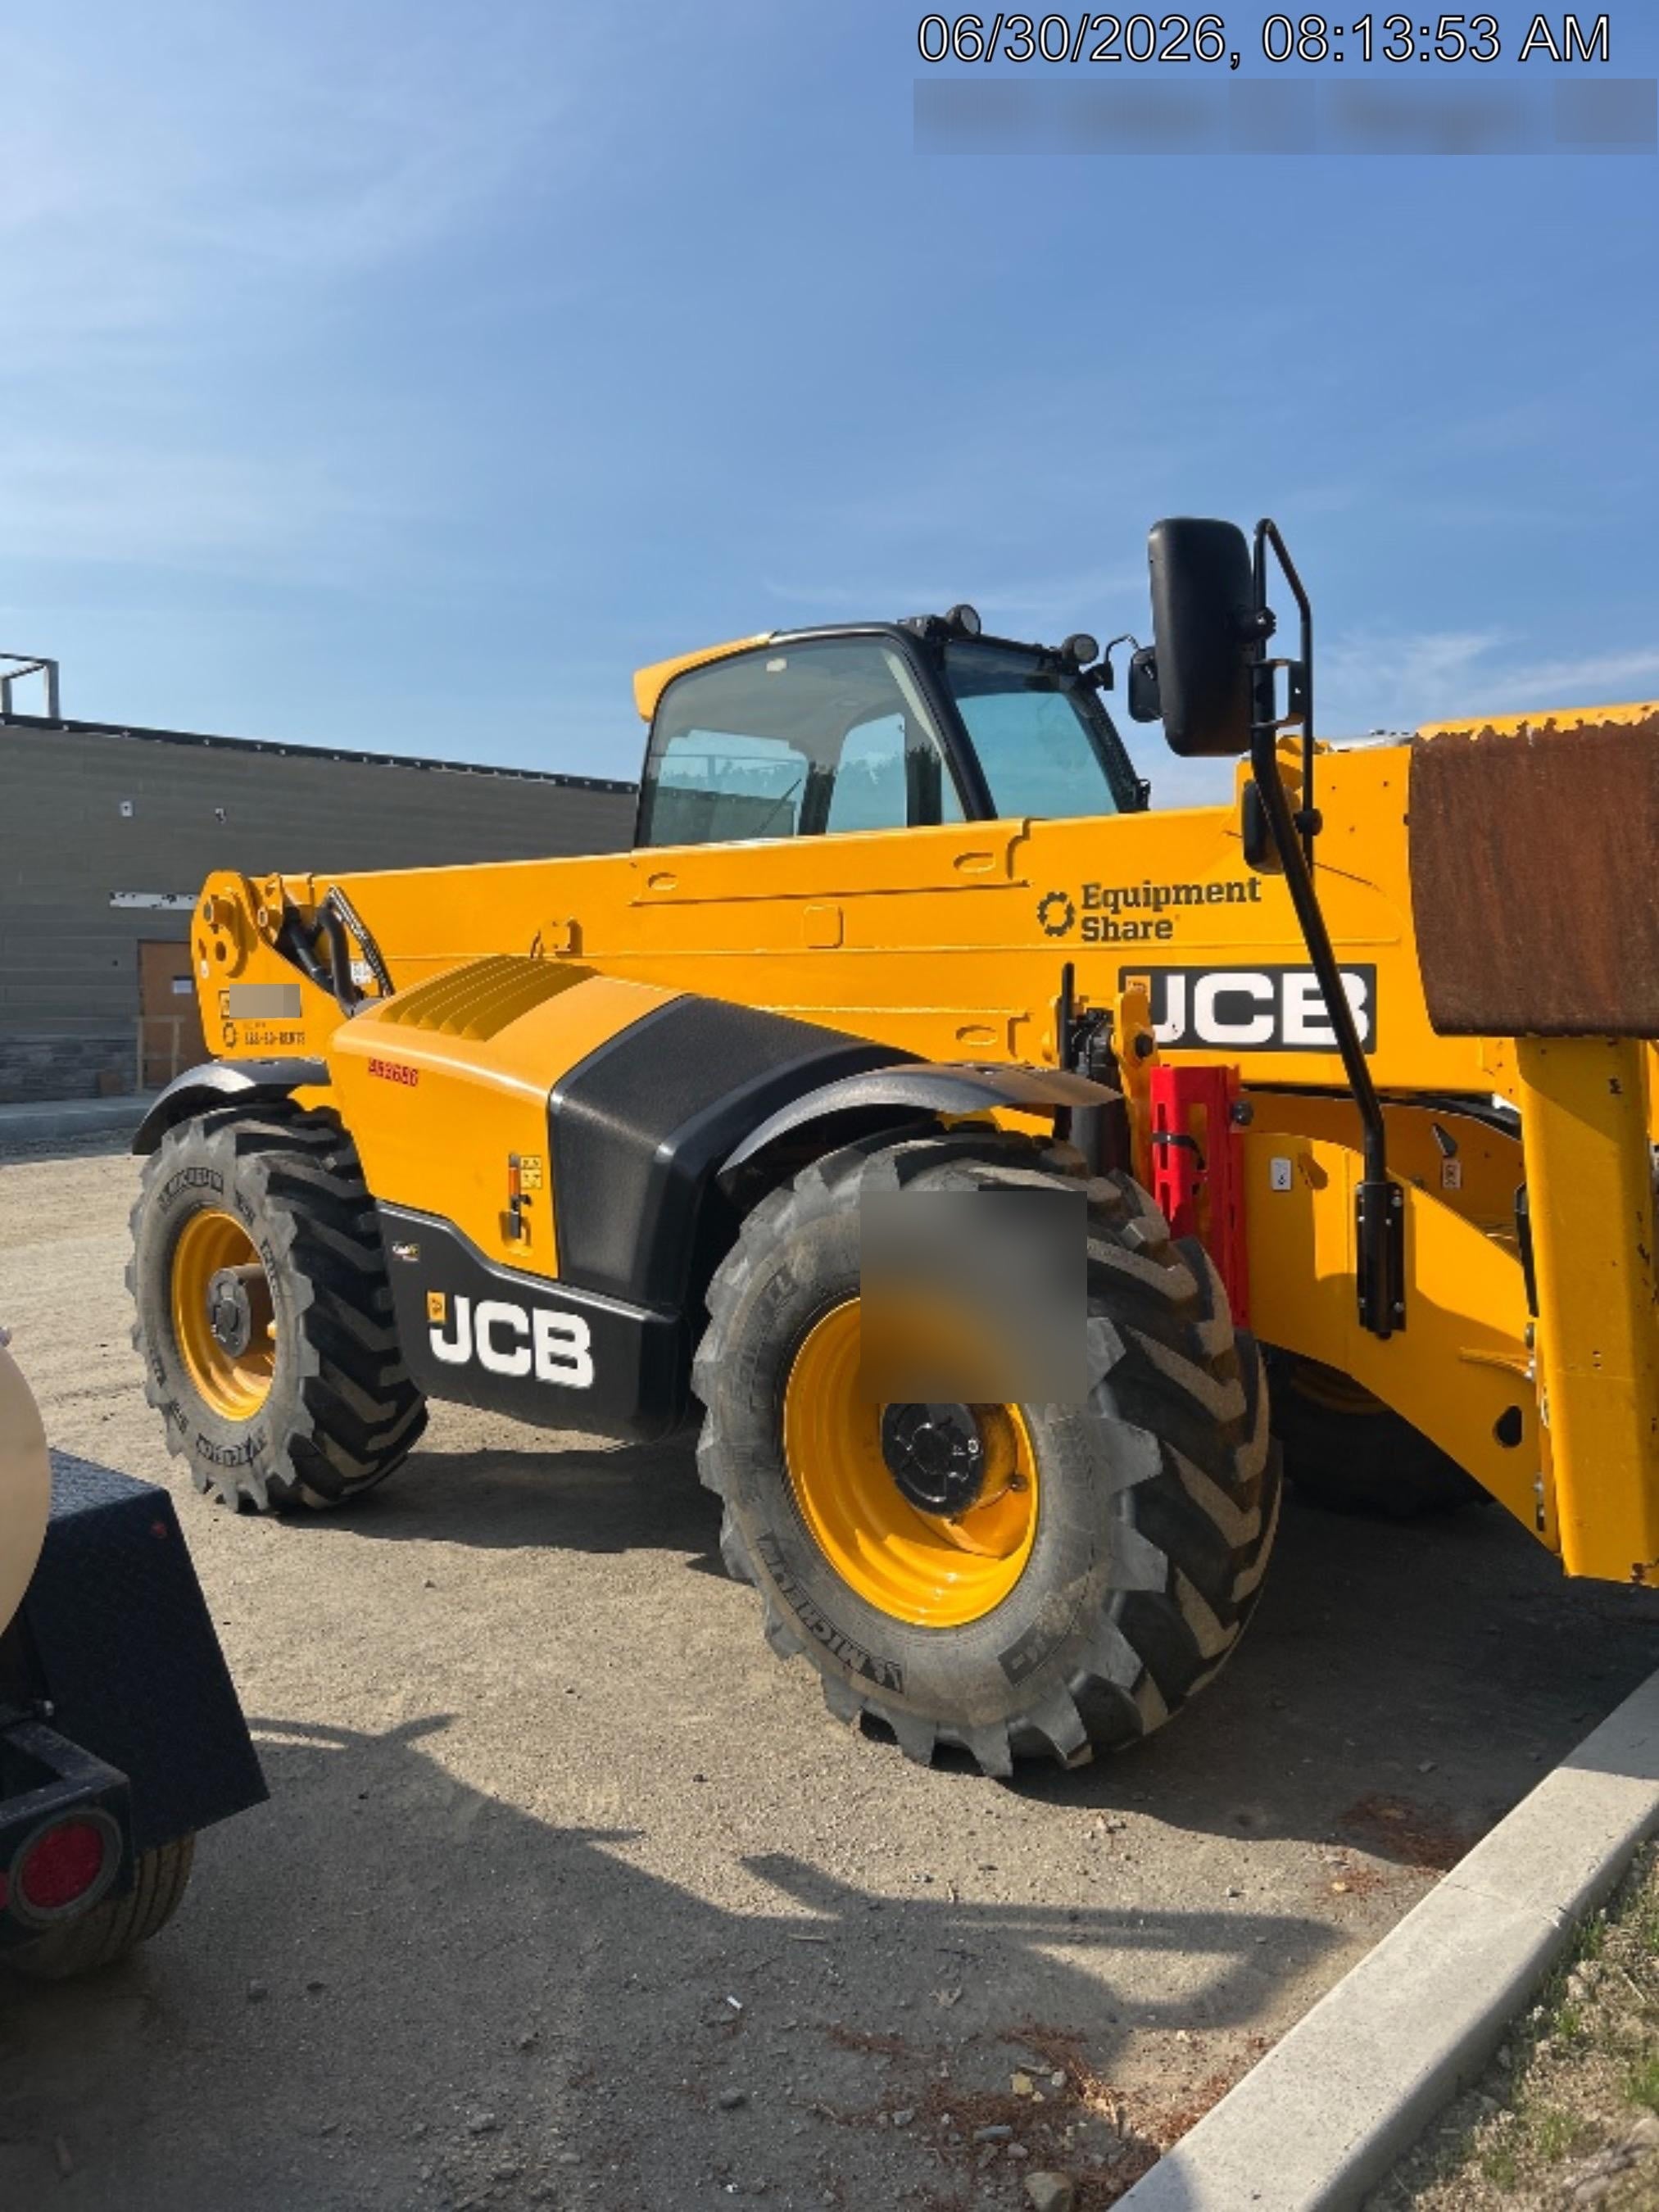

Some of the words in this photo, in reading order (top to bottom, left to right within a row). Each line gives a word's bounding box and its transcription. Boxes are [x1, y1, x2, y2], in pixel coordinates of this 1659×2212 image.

[1081, 877, 1262, 914] Equipment
[1081, 915, 1173, 941] Share
[429, 1295, 595, 1389] JCB
